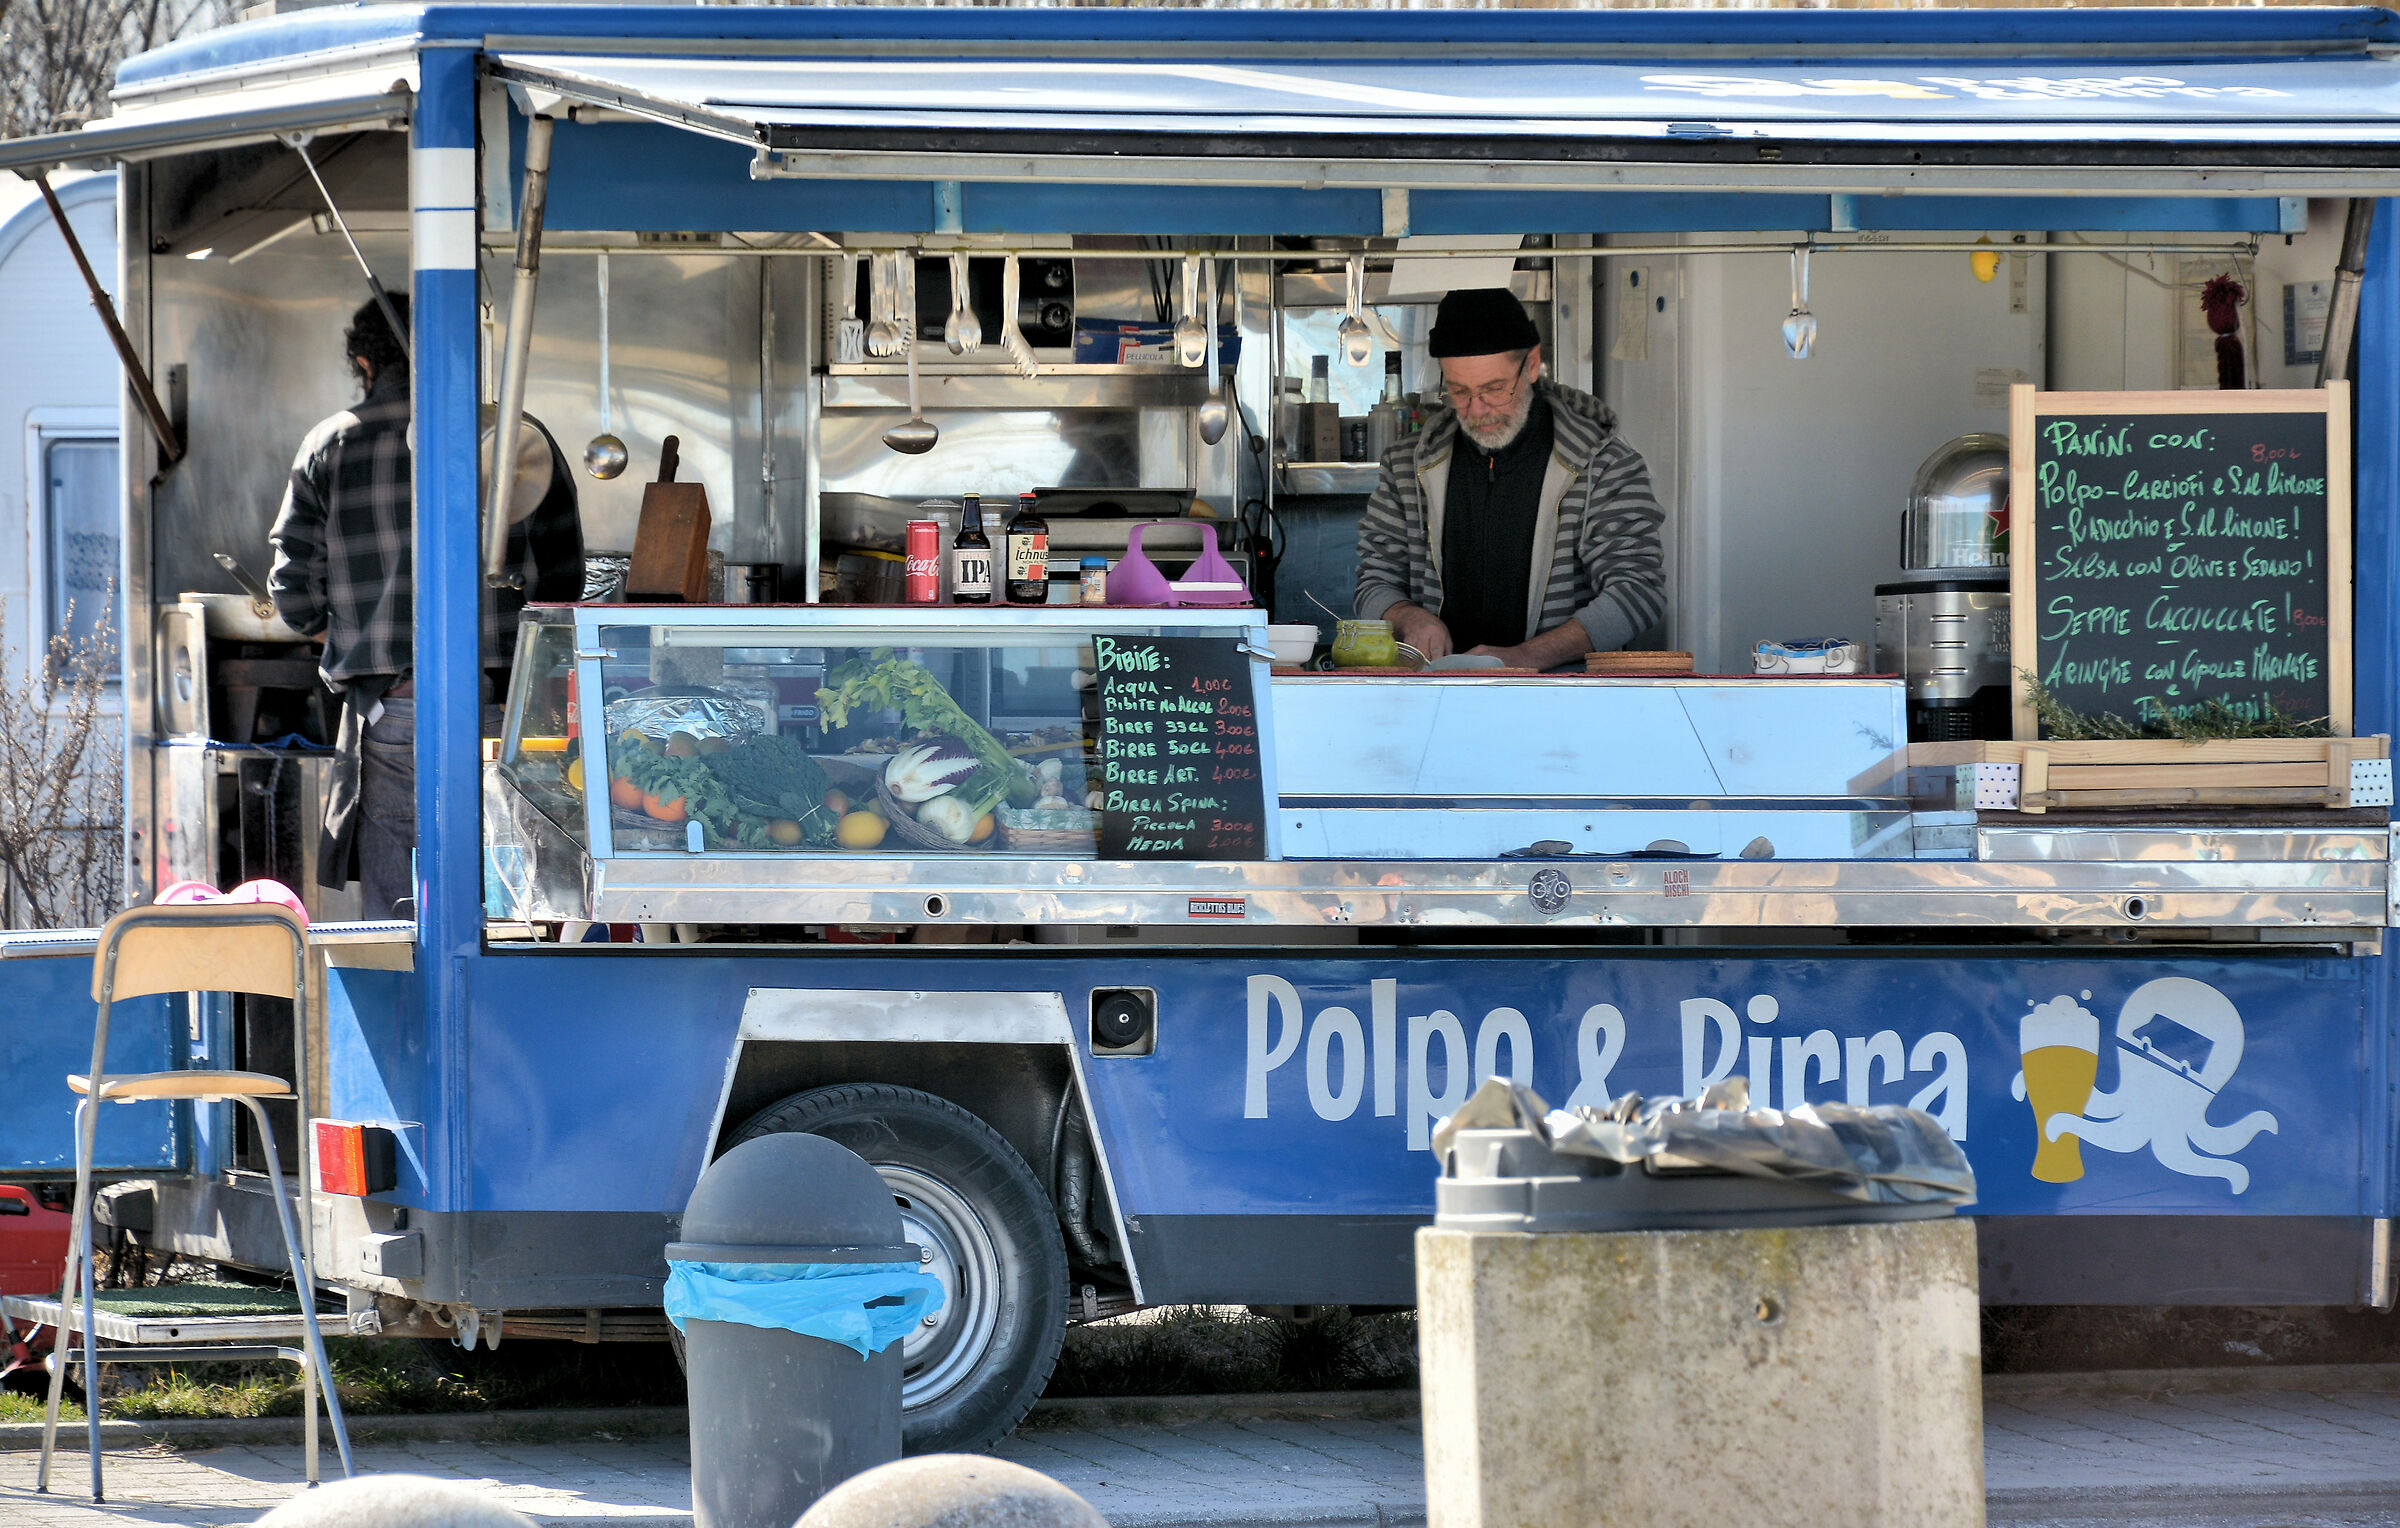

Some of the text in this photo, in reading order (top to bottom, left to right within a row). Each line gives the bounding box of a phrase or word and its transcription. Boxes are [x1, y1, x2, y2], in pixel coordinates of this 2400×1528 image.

[1126, 352, 1164, 361] PELLICOLA
[961, 559, 991, 583] IPA
[2041, 595, 2131, 641] SEPPIE
[1105, 717, 1154, 734] BIRRE
[1105, 761, 1158, 784] BIRRE
[1106, 790, 1163, 813] BIRRA
[1126, 835, 1184, 851] MEDIA
[1244, 974, 1533, 1151] Polpo
[1564, 1003, 1627, 1111] &
